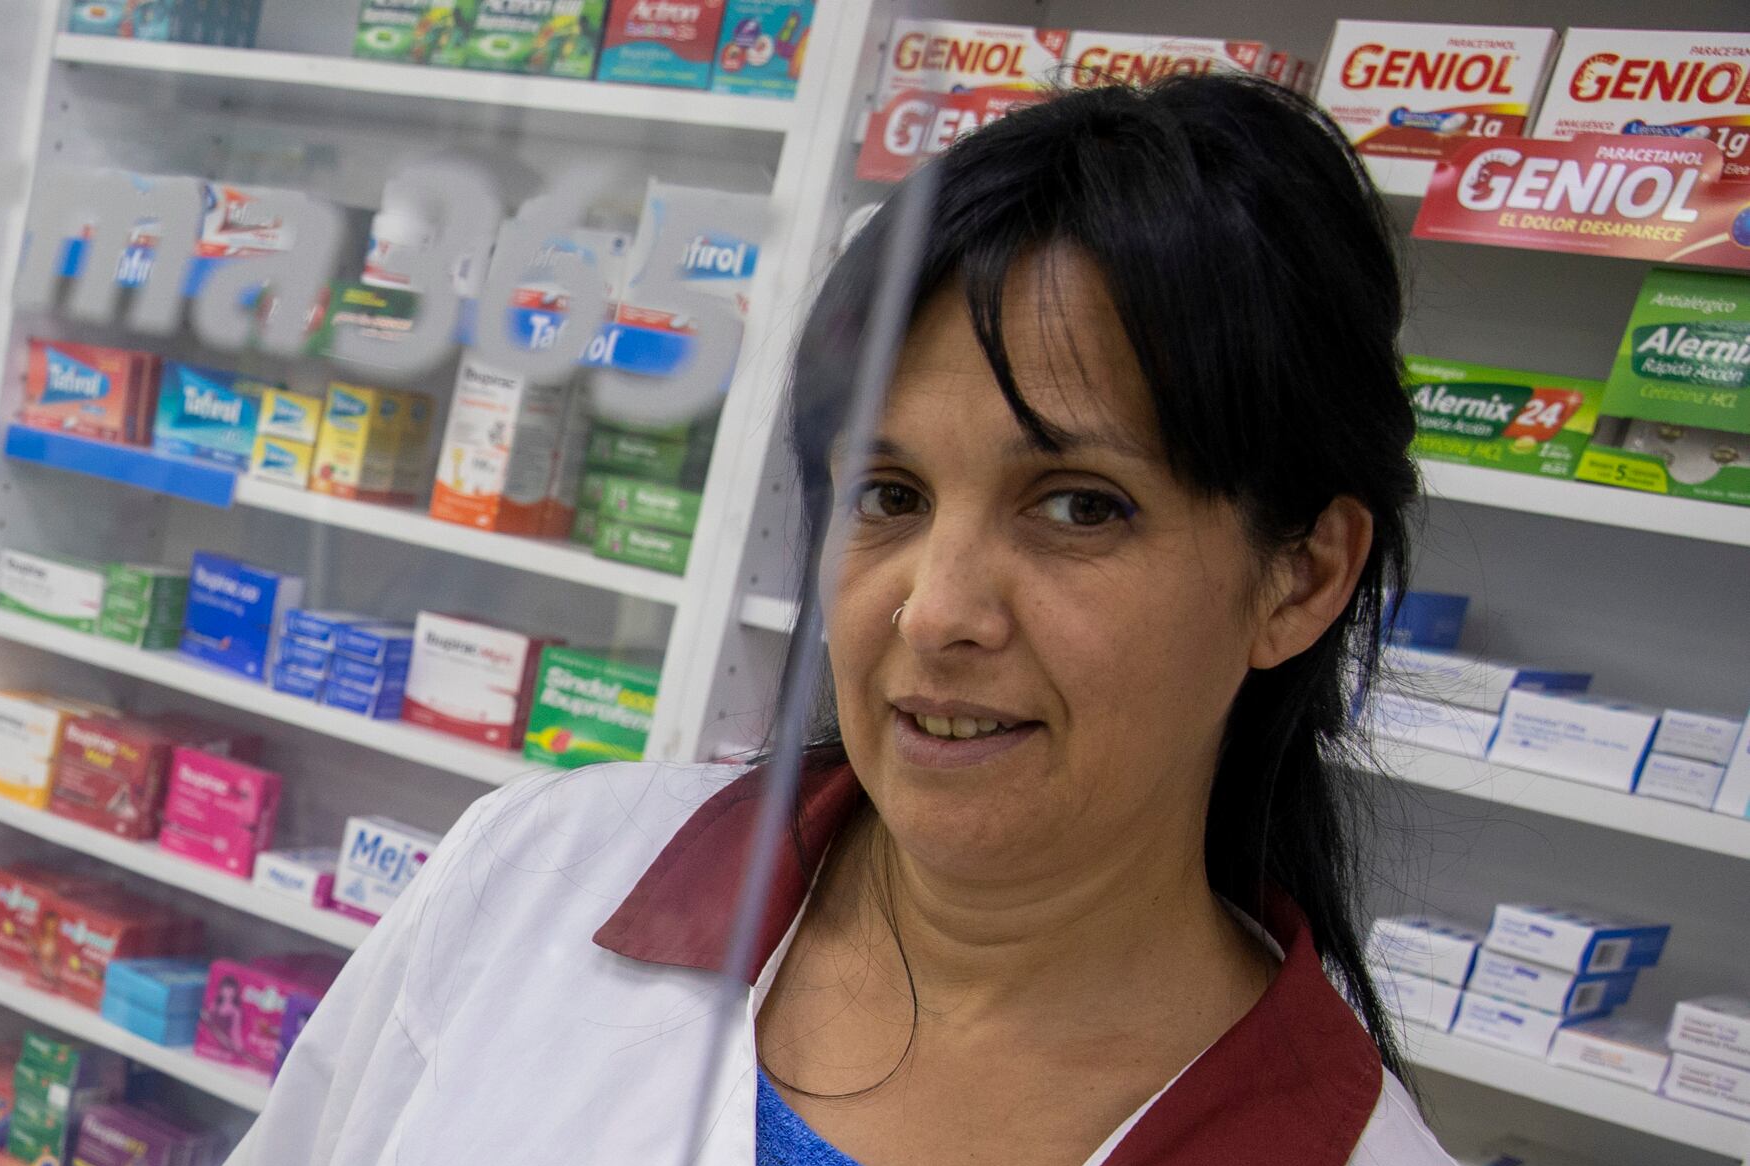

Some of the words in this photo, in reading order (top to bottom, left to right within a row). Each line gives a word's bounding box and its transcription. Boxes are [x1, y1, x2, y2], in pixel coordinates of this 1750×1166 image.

[893, 31, 1030, 78] GENIOL
[1447, 37, 1517, 50] PARACETAMOL
[1340, 43, 1516, 95] GENIOL
[1596, 146, 1703, 165] PARACETAMOL
[1457, 148, 1699, 223] GENIOL
[1499, 212, 1517, 228] EL
[1519, 214, 1576, 232] DOLOR
[1578, 220, 1687, 243] DESAPARECE
[183, 385, 241, 425] Tafirol
[1413, 384, 1514, 423] Alernix
[1515, 398, 1563, 429] 24
